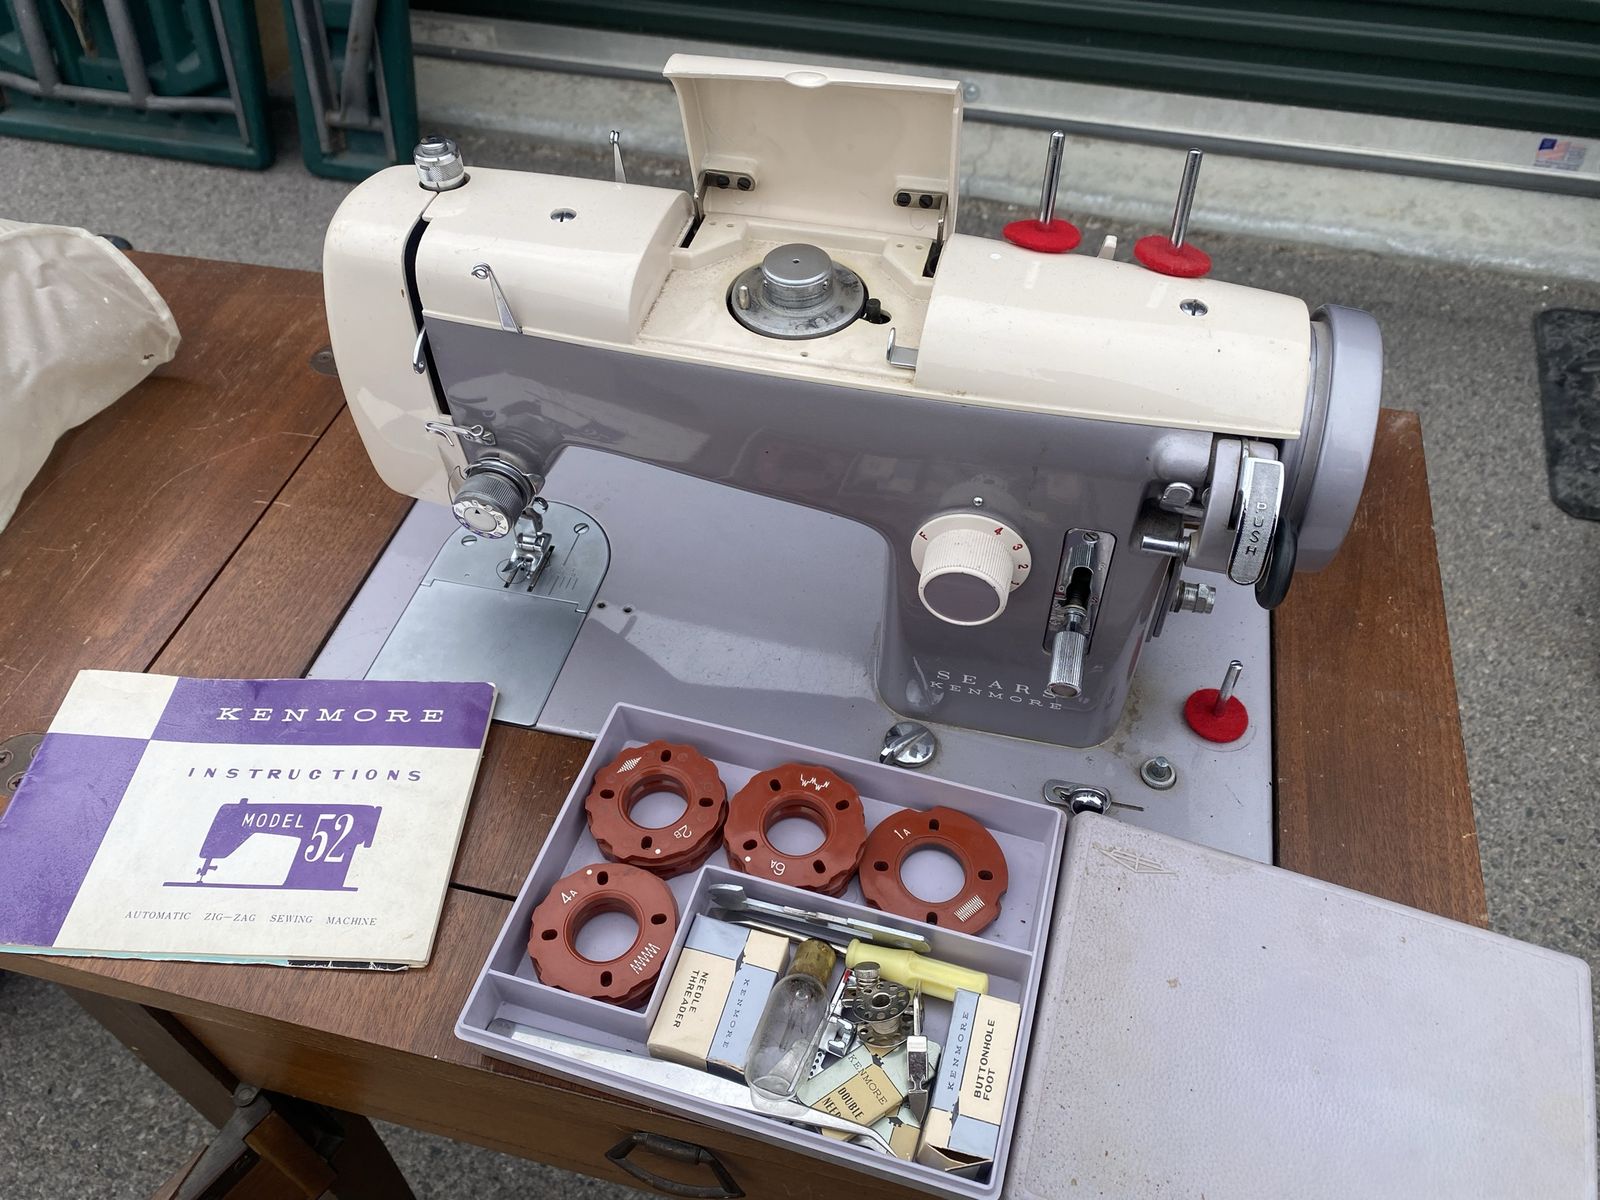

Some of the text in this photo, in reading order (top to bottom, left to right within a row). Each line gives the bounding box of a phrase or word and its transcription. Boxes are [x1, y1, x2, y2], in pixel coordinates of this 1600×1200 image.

[919, 531, 928, 541] F
[994, 527, 1004, 536] 4
[1245, 502, 1267, 556] PUSH
[1012, 543, 1023, 551] 3
[930, 681, 1062, 710] KENMORE
[937, 670, 1056, 699] SEARS
[216, 707, 444, 723] KENMORE
[188, 767, 421, 782] INSTRUCTIONS
[241, 813, 354, 863] MODEL 52
[673, 824, 692, 839] 2B
[894, 828, 911, 840] 1A
[770, 859, 786, 875] 6A
[561, 888, 578, 905] 4A
[125, 911, 191, 920] AUTOMATIC
[269, 914, 313, 923] SEWING
[326, 916, 377, 926] MACHINE
[673, 970, 701, 1028] THREADER
[689, 971, 709, 1013] NEEDLE
[723, 978, 750, 1048] KENMORE
[948, 1011, 969, 1090] KENMORE
[974, 1019, 996, 1098] BUTTONHOLE
[848, 1054, 888, 1106] KENMORE
[982, 1069, 996, 1101] FOOT
[837, 1087, 865, 1120] DOUBLE
